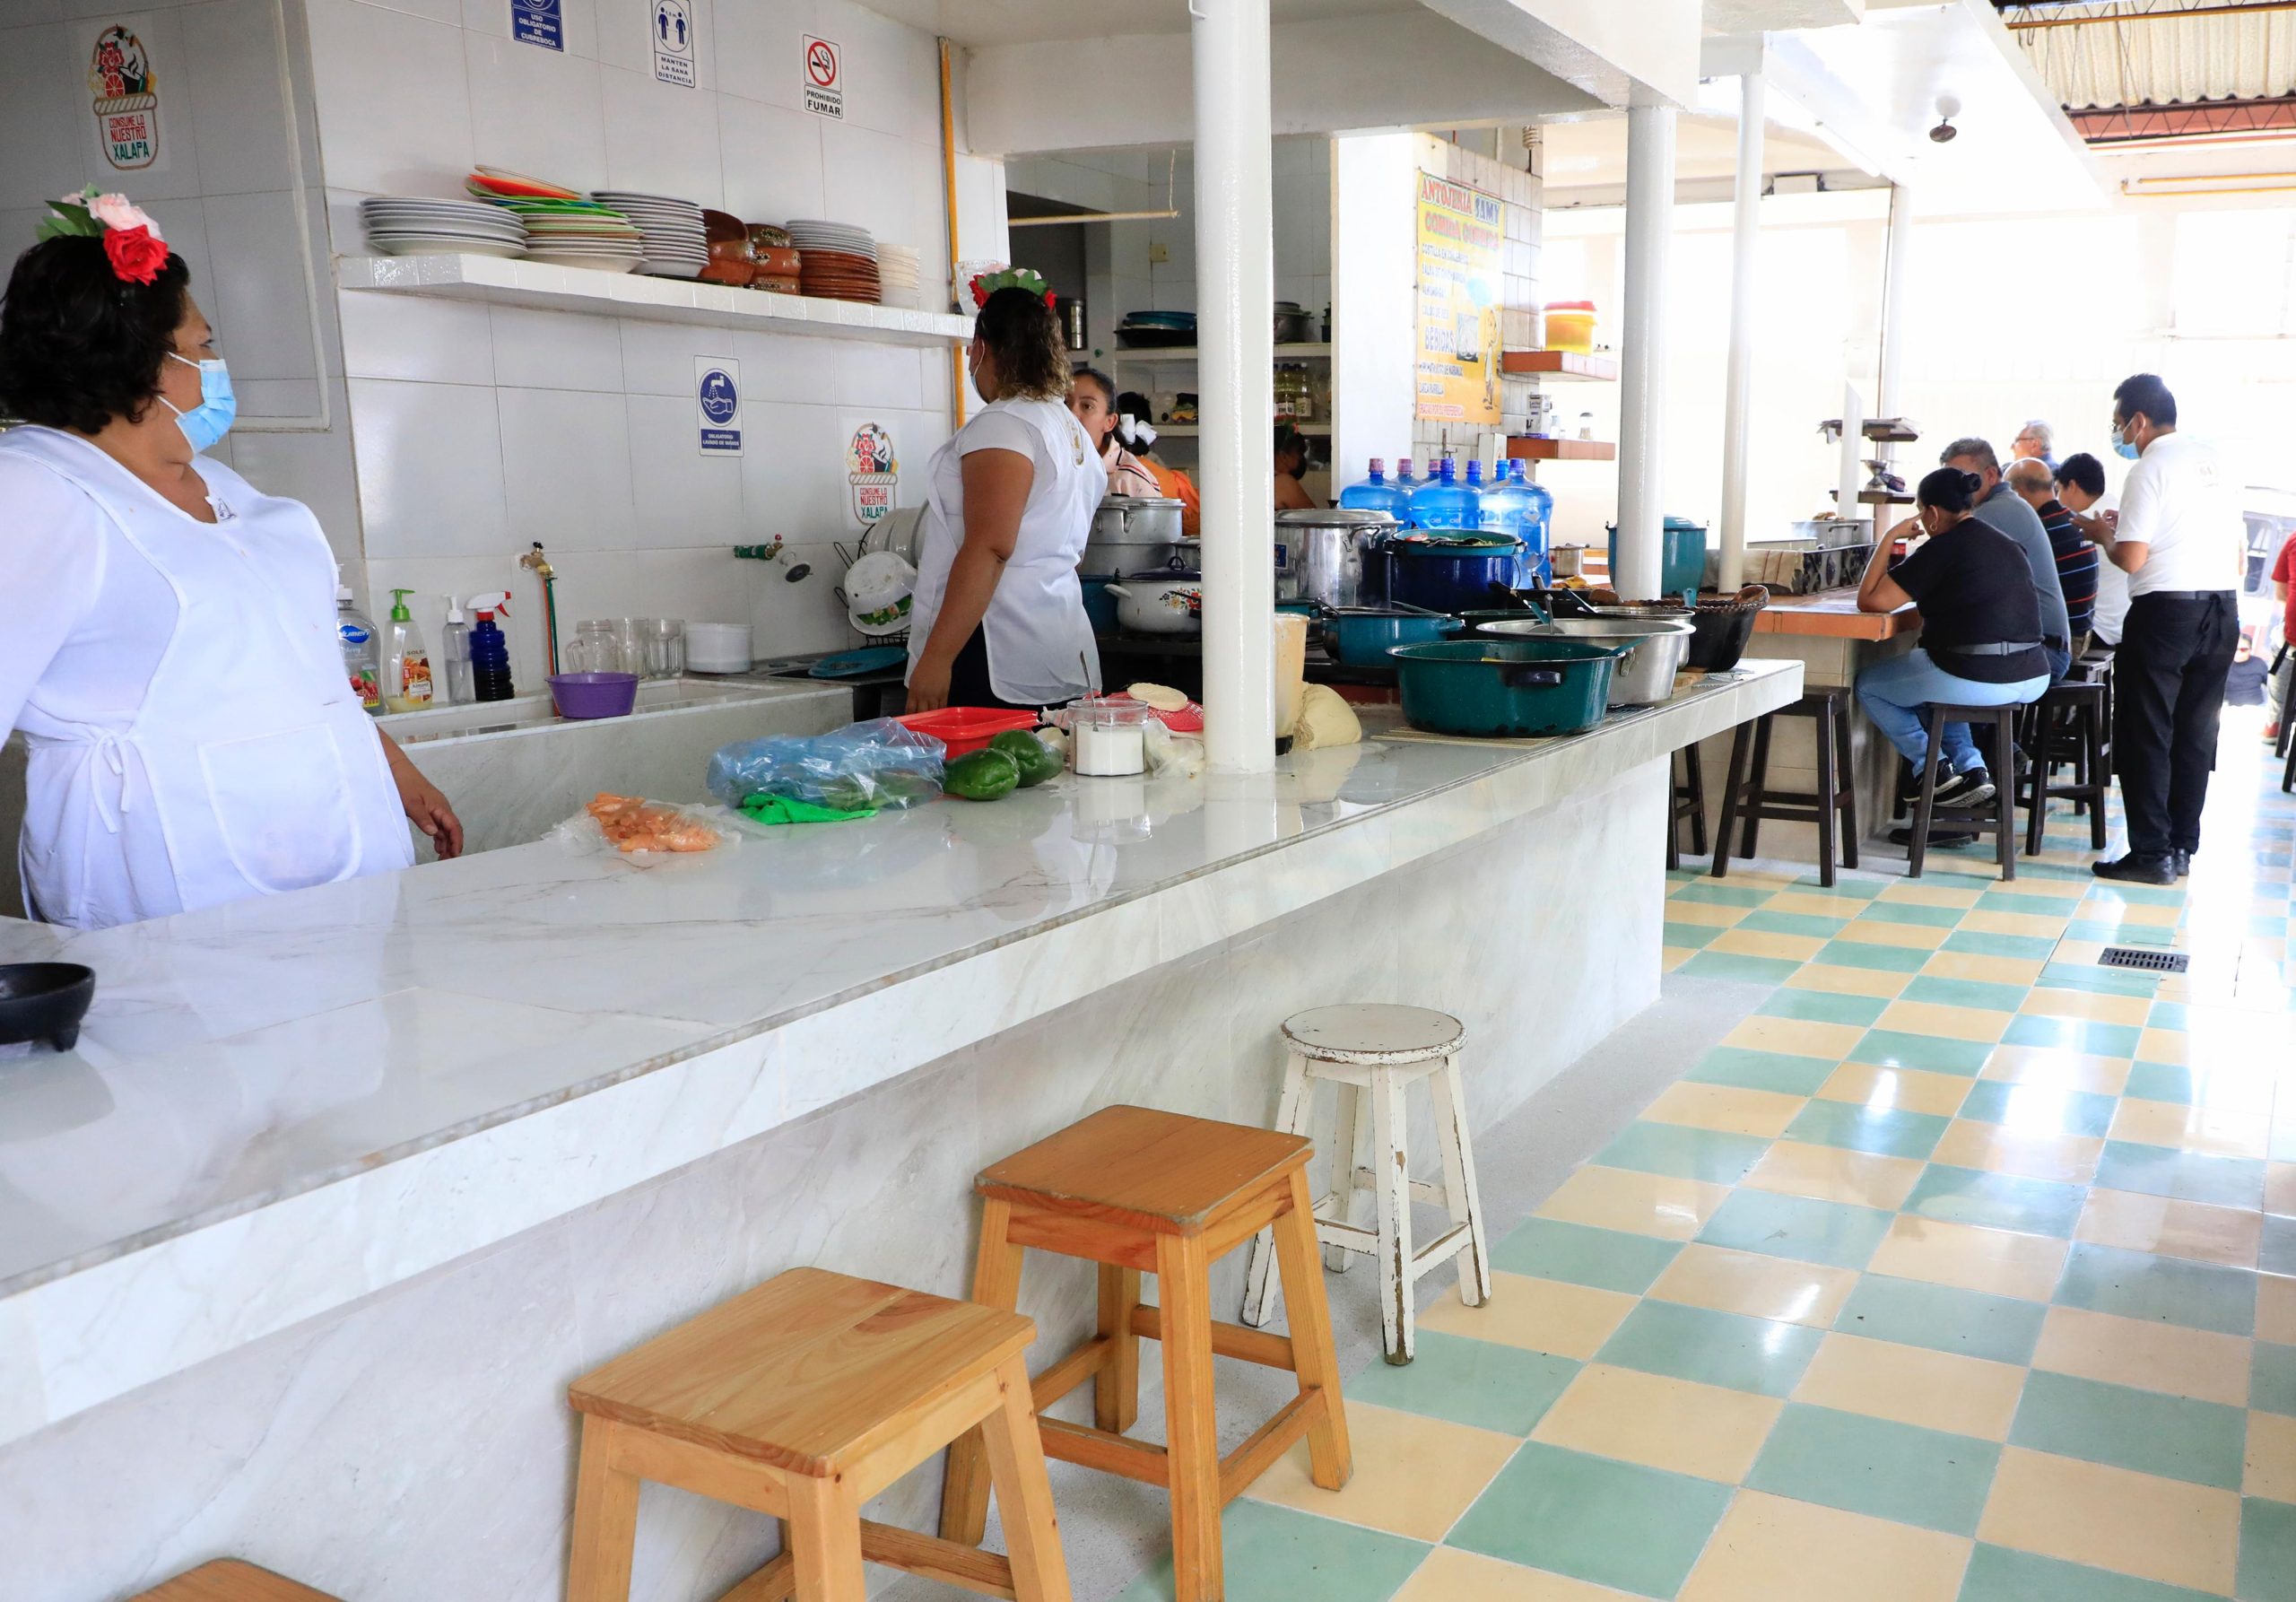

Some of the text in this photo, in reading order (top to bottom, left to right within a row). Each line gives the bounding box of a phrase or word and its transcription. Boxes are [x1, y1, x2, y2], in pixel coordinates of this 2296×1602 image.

[518, 17, 556, 32] OBLIGATORIO
[531, 13, 544, 22] USO
[521, 32, 556, 46] CUBREBOCA
[534, 28, 543, 36] DE
[661, 57, 688, 67] MANTEN
[658, 71, 692, 84] DISTANCIA
[671, 67, 689, 75] SANA
[806, 90, 841, 105] PROHIBIDO
[807, 99, 841, 117] FUMAR
[109, 114, 144, 128] CONSUME LO
[110, 126, 147, 143] NUESTRO
[112, 141, 150, 161] XALAPA
[1421, 175, 1500, 226] ANTOJERIA SAMY
[1424, 210, 1462, 242] COMIDA
[860, 487, 887, 496] CONSUME LO
[861, 495, 888, 506] NUESTRO
